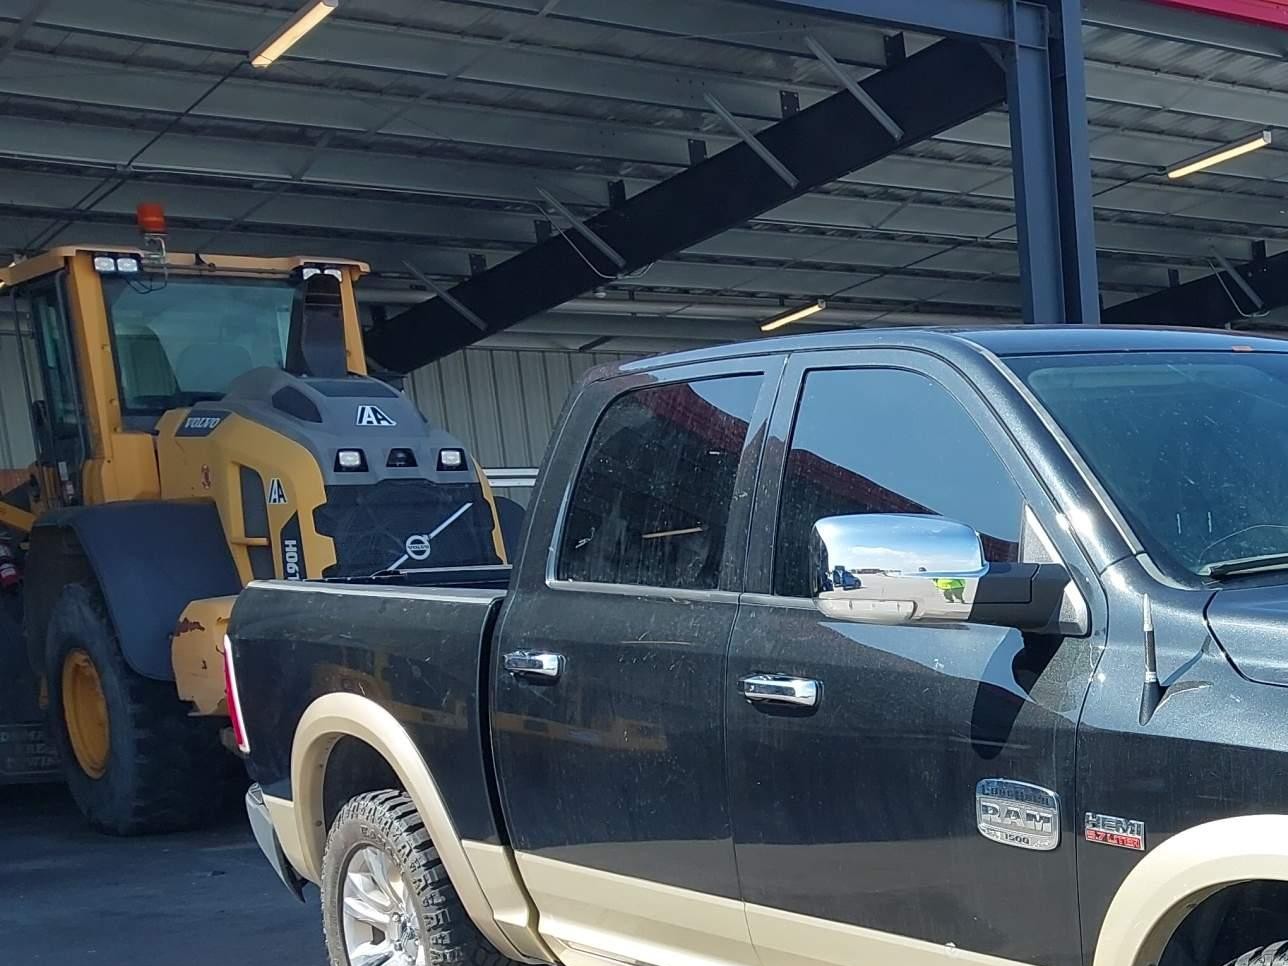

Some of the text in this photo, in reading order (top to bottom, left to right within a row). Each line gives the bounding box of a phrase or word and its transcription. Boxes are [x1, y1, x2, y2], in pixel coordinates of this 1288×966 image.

[184, 416, 221, 430] VOLVO
[284, 540, 300, 580] L90H
[981, 801, 1053, 834] RAM
[1085, 812, 1145, 838] HEMI
[1005, 833, 1031, 845] 1500
[1087, 829, 1140, 850] 5.7 LITER
